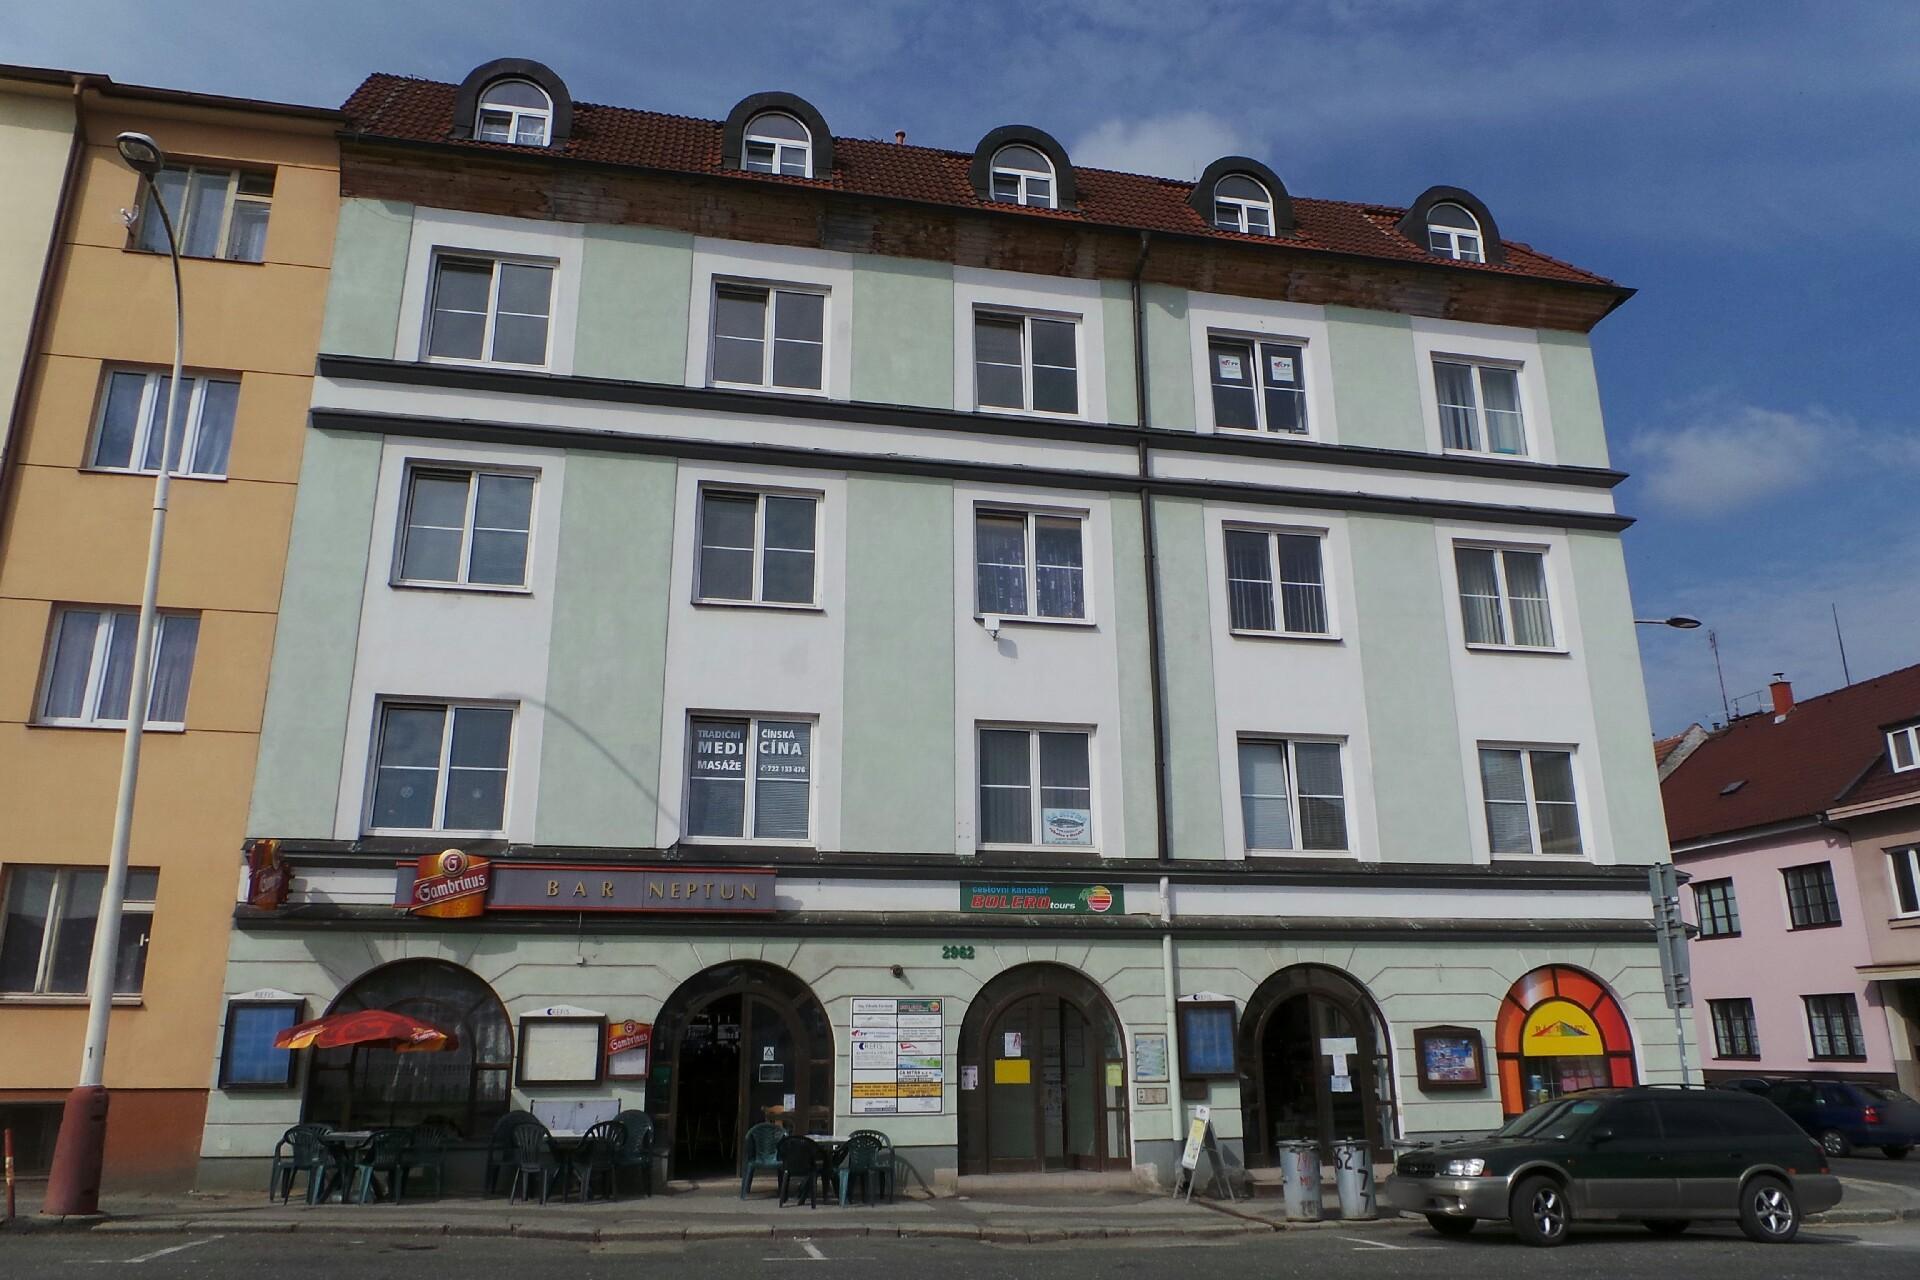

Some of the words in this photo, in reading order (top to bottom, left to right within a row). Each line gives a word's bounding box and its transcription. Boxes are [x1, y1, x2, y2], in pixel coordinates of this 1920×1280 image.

[697, 729, 741, 739] TRADIČNÍ
[761, 728, 795, 739] ČÍNSKÁ
[698, 741, 744, 755] MEDI
[759, 740, 802, 755] CÍNA
[697, 759, 742, 771] MASÁŽE
[416, 874, 486, 901] Gambrinus
[547, 879, 614, 897] BAR
[649, 881, 757, 900] NEPTUN
[971, 895, 1050, 909] BOLERO
[1050, 901, 1076, 910] tours
[611, 1033, 648, 1050] Gambrinus
